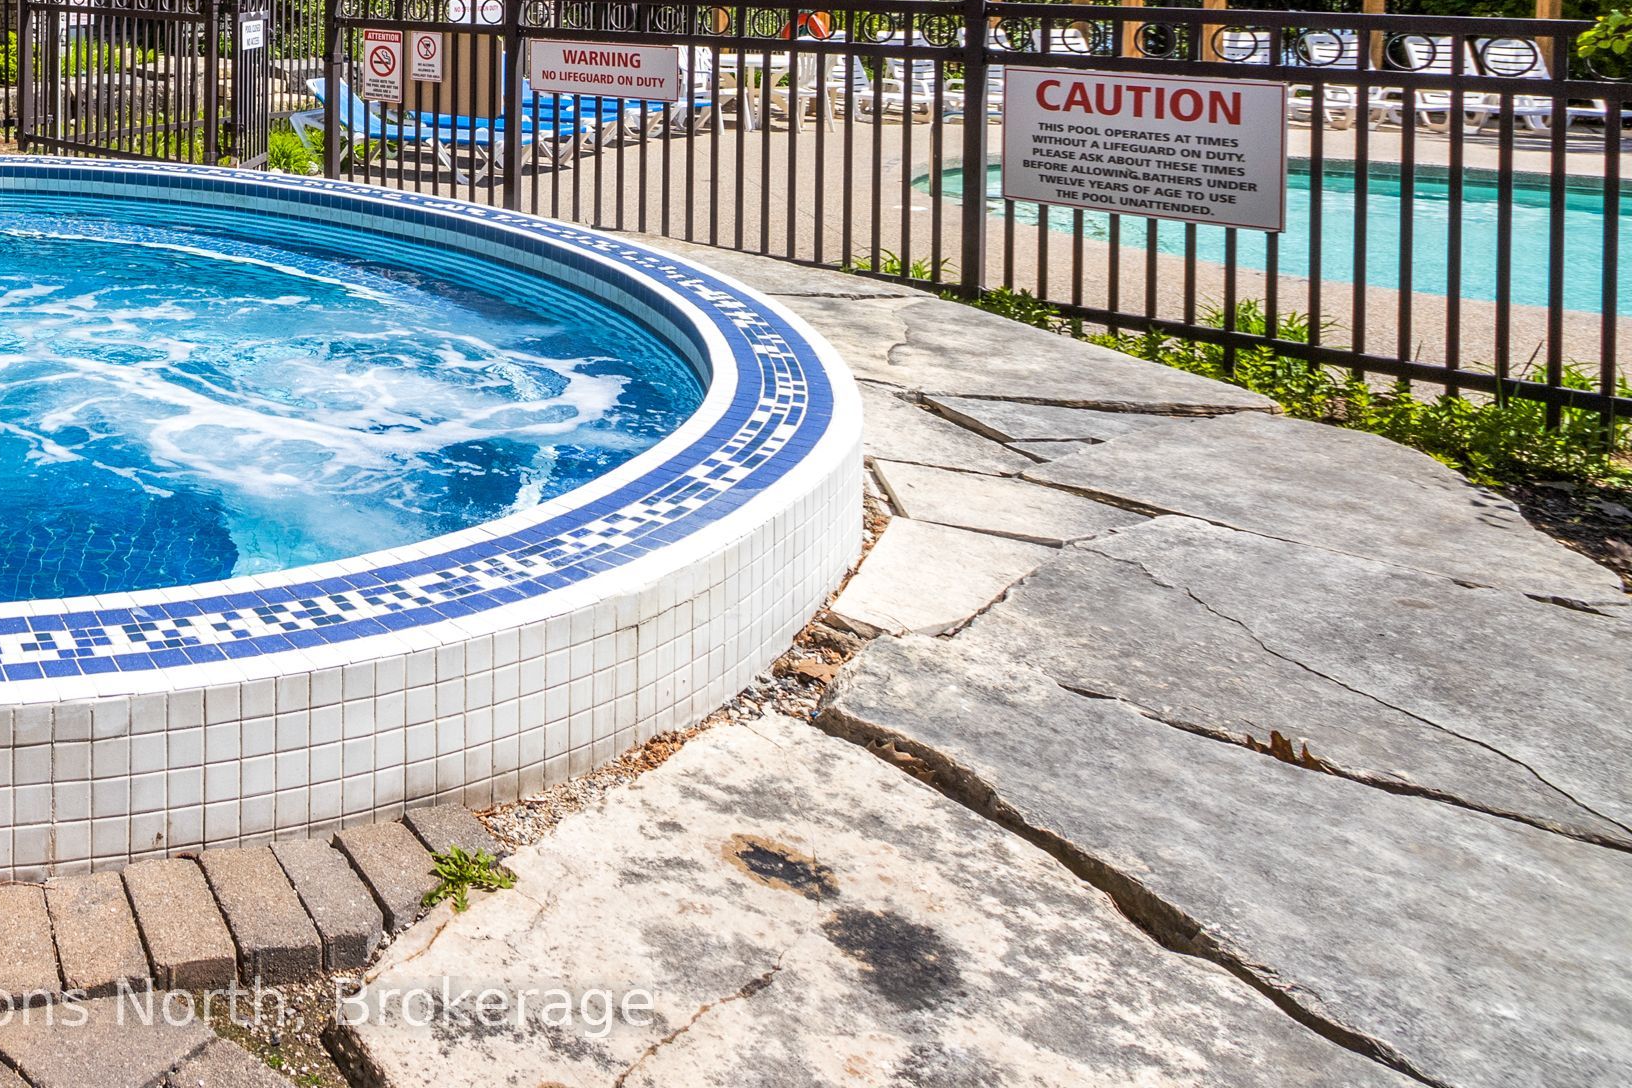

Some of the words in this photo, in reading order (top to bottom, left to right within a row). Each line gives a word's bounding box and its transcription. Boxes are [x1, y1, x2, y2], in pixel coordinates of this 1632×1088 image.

[368, 33, 399, 41] ATTENTION
[562, 49, 641, 68] WARNING
[542, 70, 556, 80] NO
[559, 71, 614, 84] LIFEGUARD
[618, 75, 633, 86] ON
[636, 77, 665, 88] DUTY
[1036, 79, 1242, 125] CAUTION
[1032, 134, 1087, 148] WITHOUT
[1091, 140, 1100, 149] A
[1104, 142, 1176, 156] LIFEGUARD
[1180, 148, 1202, 159] ON
[1206, 151, 1246, 162] DUTY.
[1038, 122, 1064, 132] THIS
[1068, 125, 1101, 136] POOL
[1104, 128, 1170, 142] OPERATES
[1174, 134, 1192, 144] AT
[1195, 136, 1239, 148] TIMES
[1023, 160, 1068, 172] BEFORE
[1142, 173, 1202, 187] BATHERS
[1207, 179, 1257, 192] UNDER
[1032, 148, 1075, 160] PLEASE
[1079, 153, 1104, 163] ASK
[1108, 156, 1152, 168] ABOUT
[1155, 160, 1197, 172] THESE
[1201, 165, 1245, 177] TIMES
[1038, 174, 1085, 188] TWELVE
[1088, 179, 1128, 192] YEARS
[1133, 185, 1151, 195] OF
[1154, 187, 1182, 199] AGE
[1186, 190, 1204, 201] TO
[1209, 192, 1237, 204] USE
[1056, 189, 1078, 200] THE
[1082, 192, 1116, 204] POOL
[1119, 196, 1214, 216] UNATTENDED.
